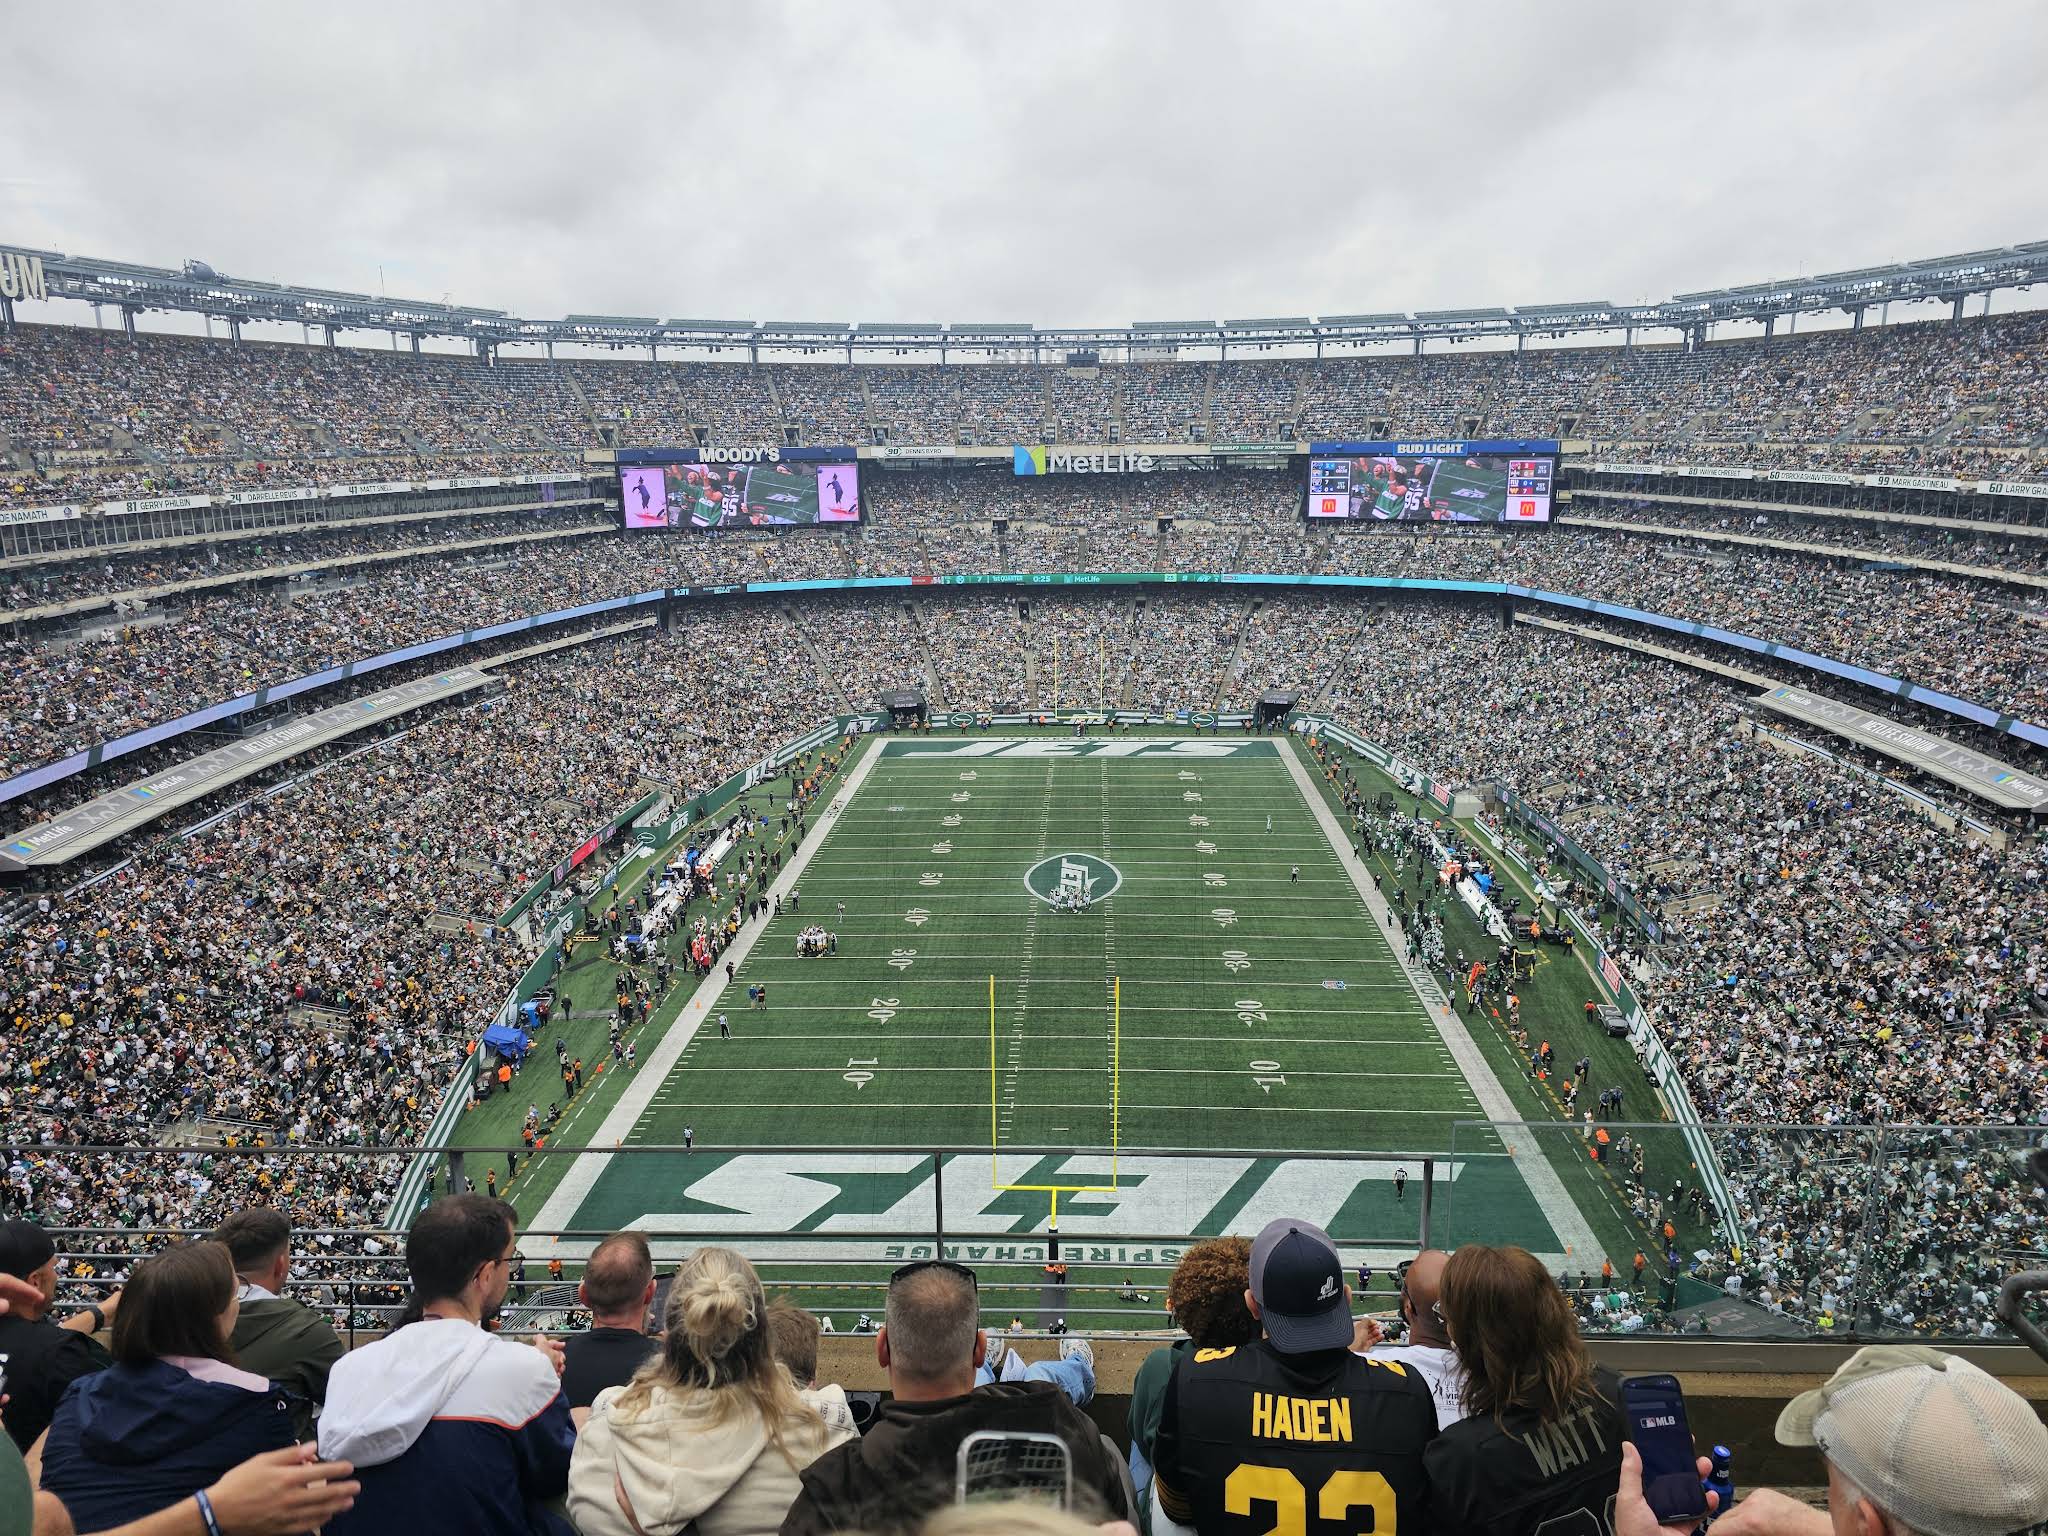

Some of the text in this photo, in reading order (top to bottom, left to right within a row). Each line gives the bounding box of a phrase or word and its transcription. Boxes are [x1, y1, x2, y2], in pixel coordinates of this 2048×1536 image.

[0, 253, 47, 300] UM
[699, 447, 780, 463] MOODY'S
[1397, 444, 1464, 454] BUD LIGHT
[1049, 449, 1153, 473] MetLife
[348, 486, 358, 494] 41
[1878, 476, 1948, 488] 99 MARK GASTINEAU
[1988, 482, 2048, 495] 60 LARRY GRA
[126, 498, 191, 512] 81 GERRY PHILBIN
[230, 490, 298, 503] 24 DARRELLE REVIS
[0, 510, 48, 523] OE NAMATH
[240, 722, 317, 754] METLIFE STADIUM
[1860, 720, 1940, 753] METLIFE STADIUM
[900, 741, 1253, 757] JETS
[1384, 758, 1424, 788] JETS
[149, 776, 186, 792] MetLife
[2006, 778, 2044, 798] MetLife
[27, 826, 74, 846] MetLife
[918, 872, 944, 886] 50
[1202, 872, 1228, 887] 50
[904, 908, 932, 924] 40
[1211, 908, 1240, 925] 40
[887, 948, 918, 967] 30
[1222, 950, 1252, 968] 30
[867, 998, 901, 1020] 20
[1234, 1000, 1268, 1022] 20
[843, 1057, 879, 1082] 10
[1249, 1060, 1287, 1086] 10
[620, 1152, 1466, 1236] JETS
[885, 1245, 1185, 1263] SPIRE CHANGE
[353, 1317, 366, 1327] 20
[1252, 1392, 1353, 1442] HADEN
[1656, 1416, 1676, 1427] MLB
[1522, 1404, 1607, 1480] WATT
